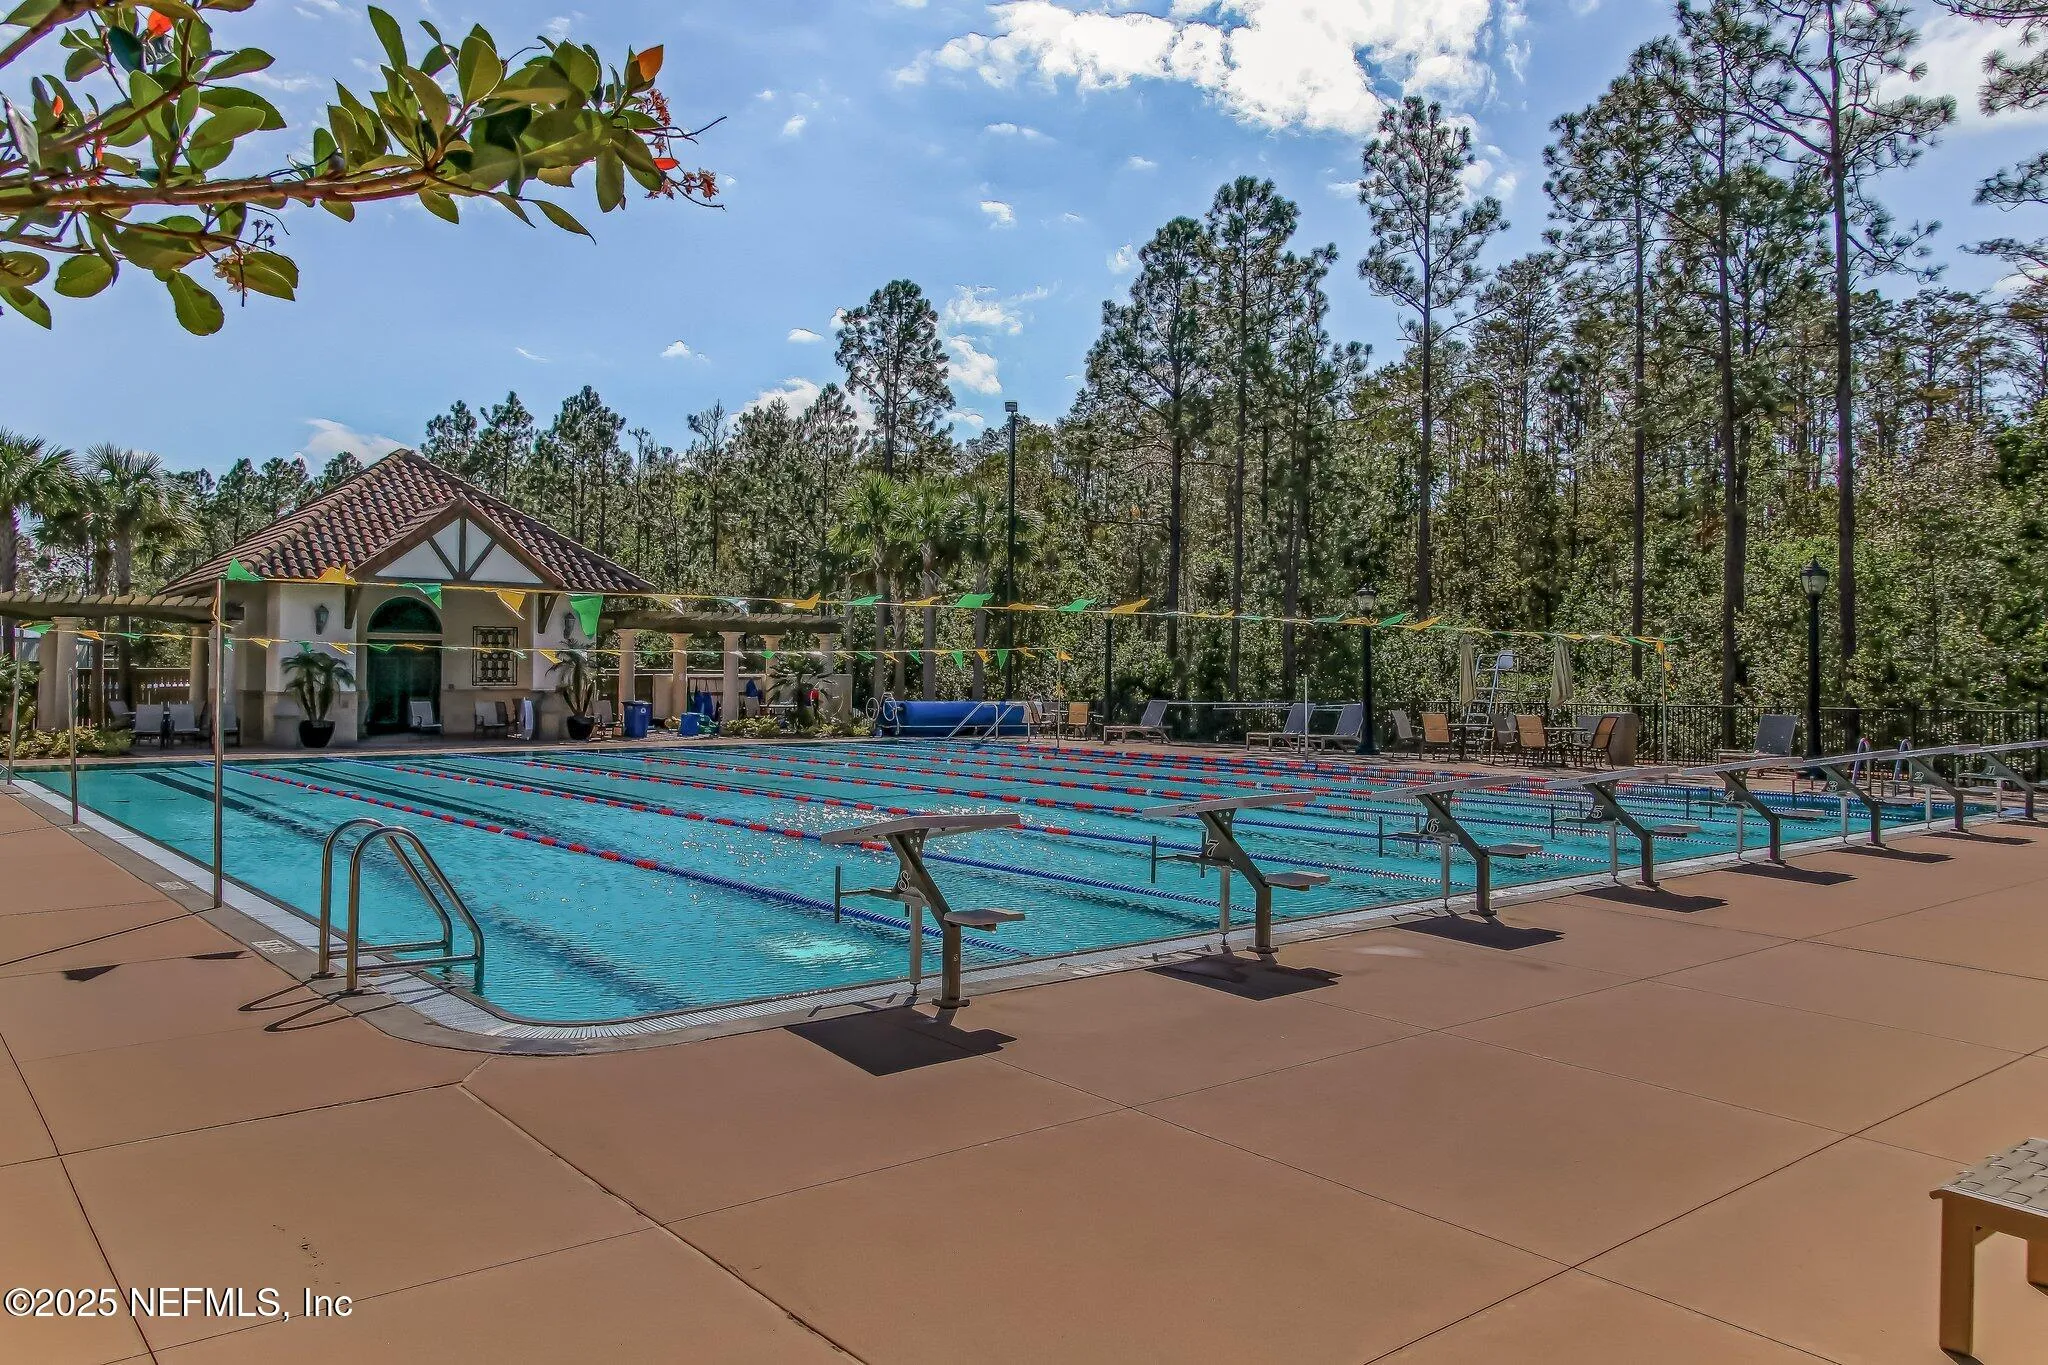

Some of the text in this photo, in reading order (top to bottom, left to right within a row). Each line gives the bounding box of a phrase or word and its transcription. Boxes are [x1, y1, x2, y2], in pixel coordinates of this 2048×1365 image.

[1913, 771, 1925, 782] 2
[1827, 781, 1838, 792] 3
[1723, 790, 1735, 802] 4
[1591, 805, 1605, 819] 5
[1426, 818, 1439, 834] 6
[1206, 839, 1220, 857] 7
[897, 869, 911, 892] 8
